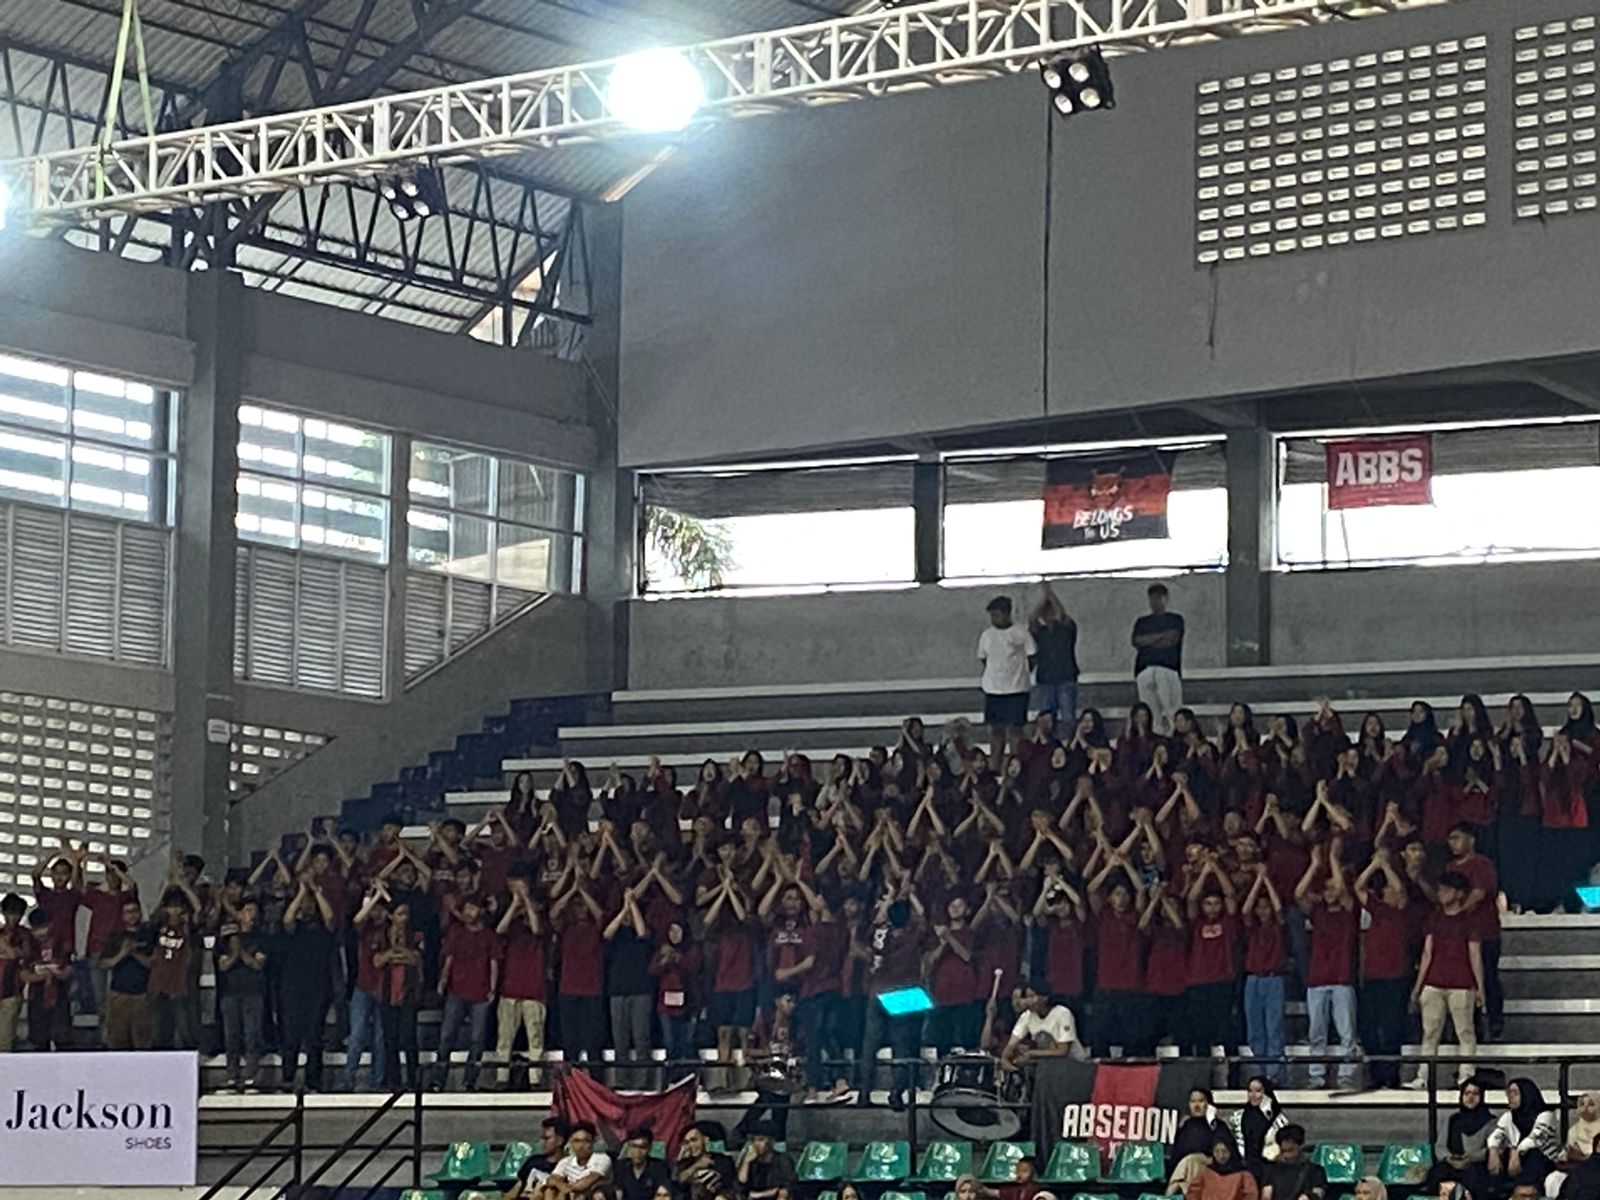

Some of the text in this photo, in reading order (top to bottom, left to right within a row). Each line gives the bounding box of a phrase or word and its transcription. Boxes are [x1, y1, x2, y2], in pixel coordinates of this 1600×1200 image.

[1335, 447, 1423, 487] ABBS
[1073, 505, 1133, 528] BELONGS
[1100, 523, 1120, 539] US
[6, 1089, 172, 1130] Jackson
[1062, 1103, 1178, 1145] ABSEDON
[125, 1136, 172, 1150] SHOES
